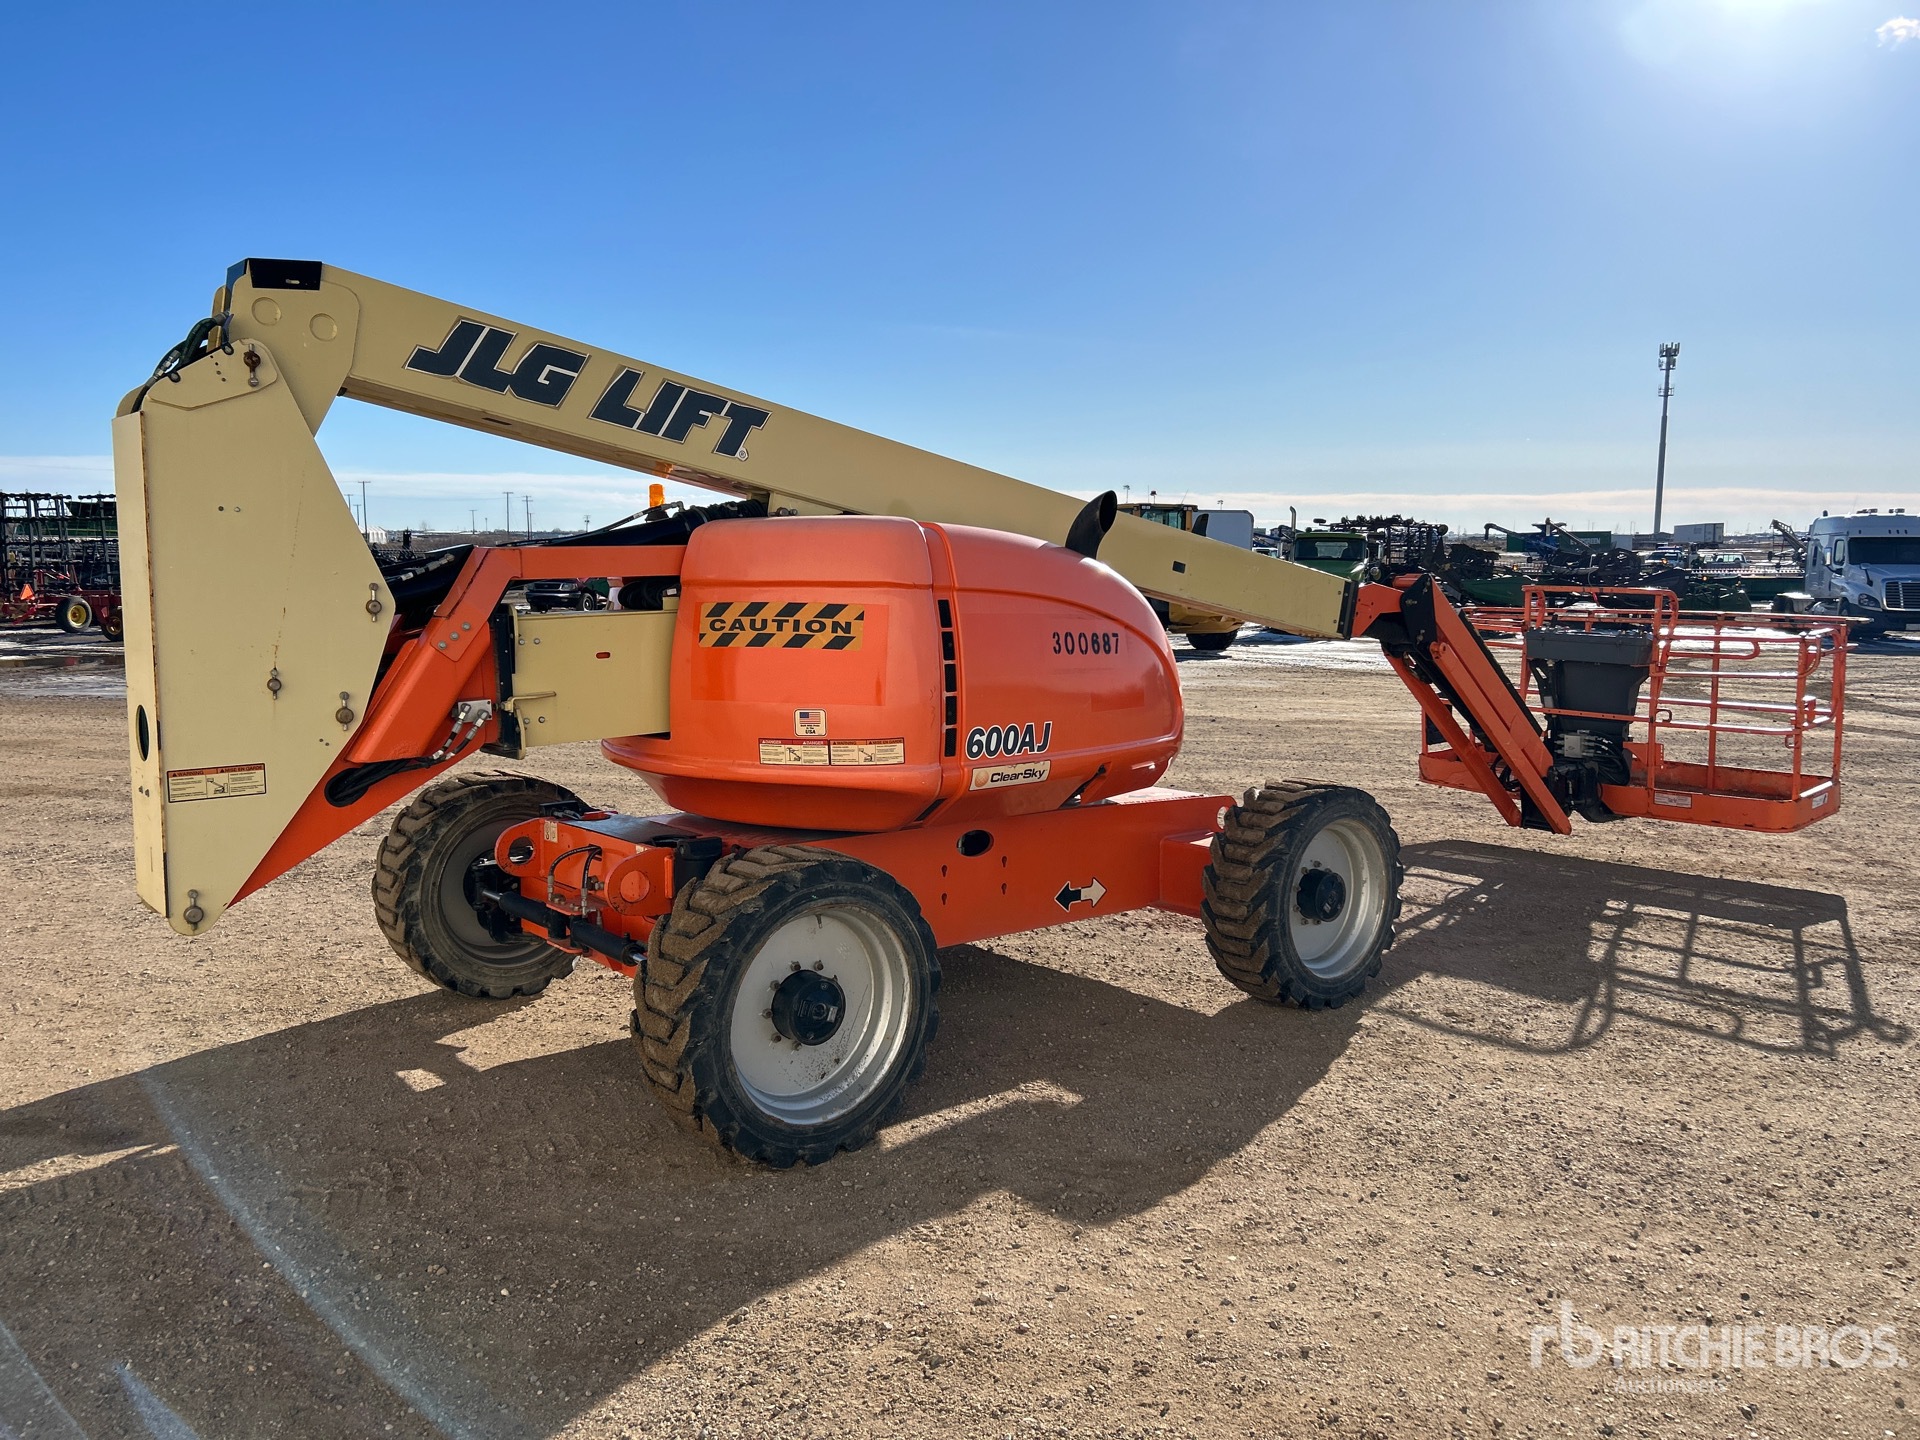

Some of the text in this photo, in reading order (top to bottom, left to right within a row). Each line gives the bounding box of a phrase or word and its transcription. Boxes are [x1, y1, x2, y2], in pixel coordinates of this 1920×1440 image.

[405, 319, 773, 458] JLG LIFT
[709, 618, 852, 635] CAUTION
[1052, 631, 1119, 655] 300687
[966, 721, 1052, 760] 600AJ
[991, 768, 1046, 783] ClearSky
